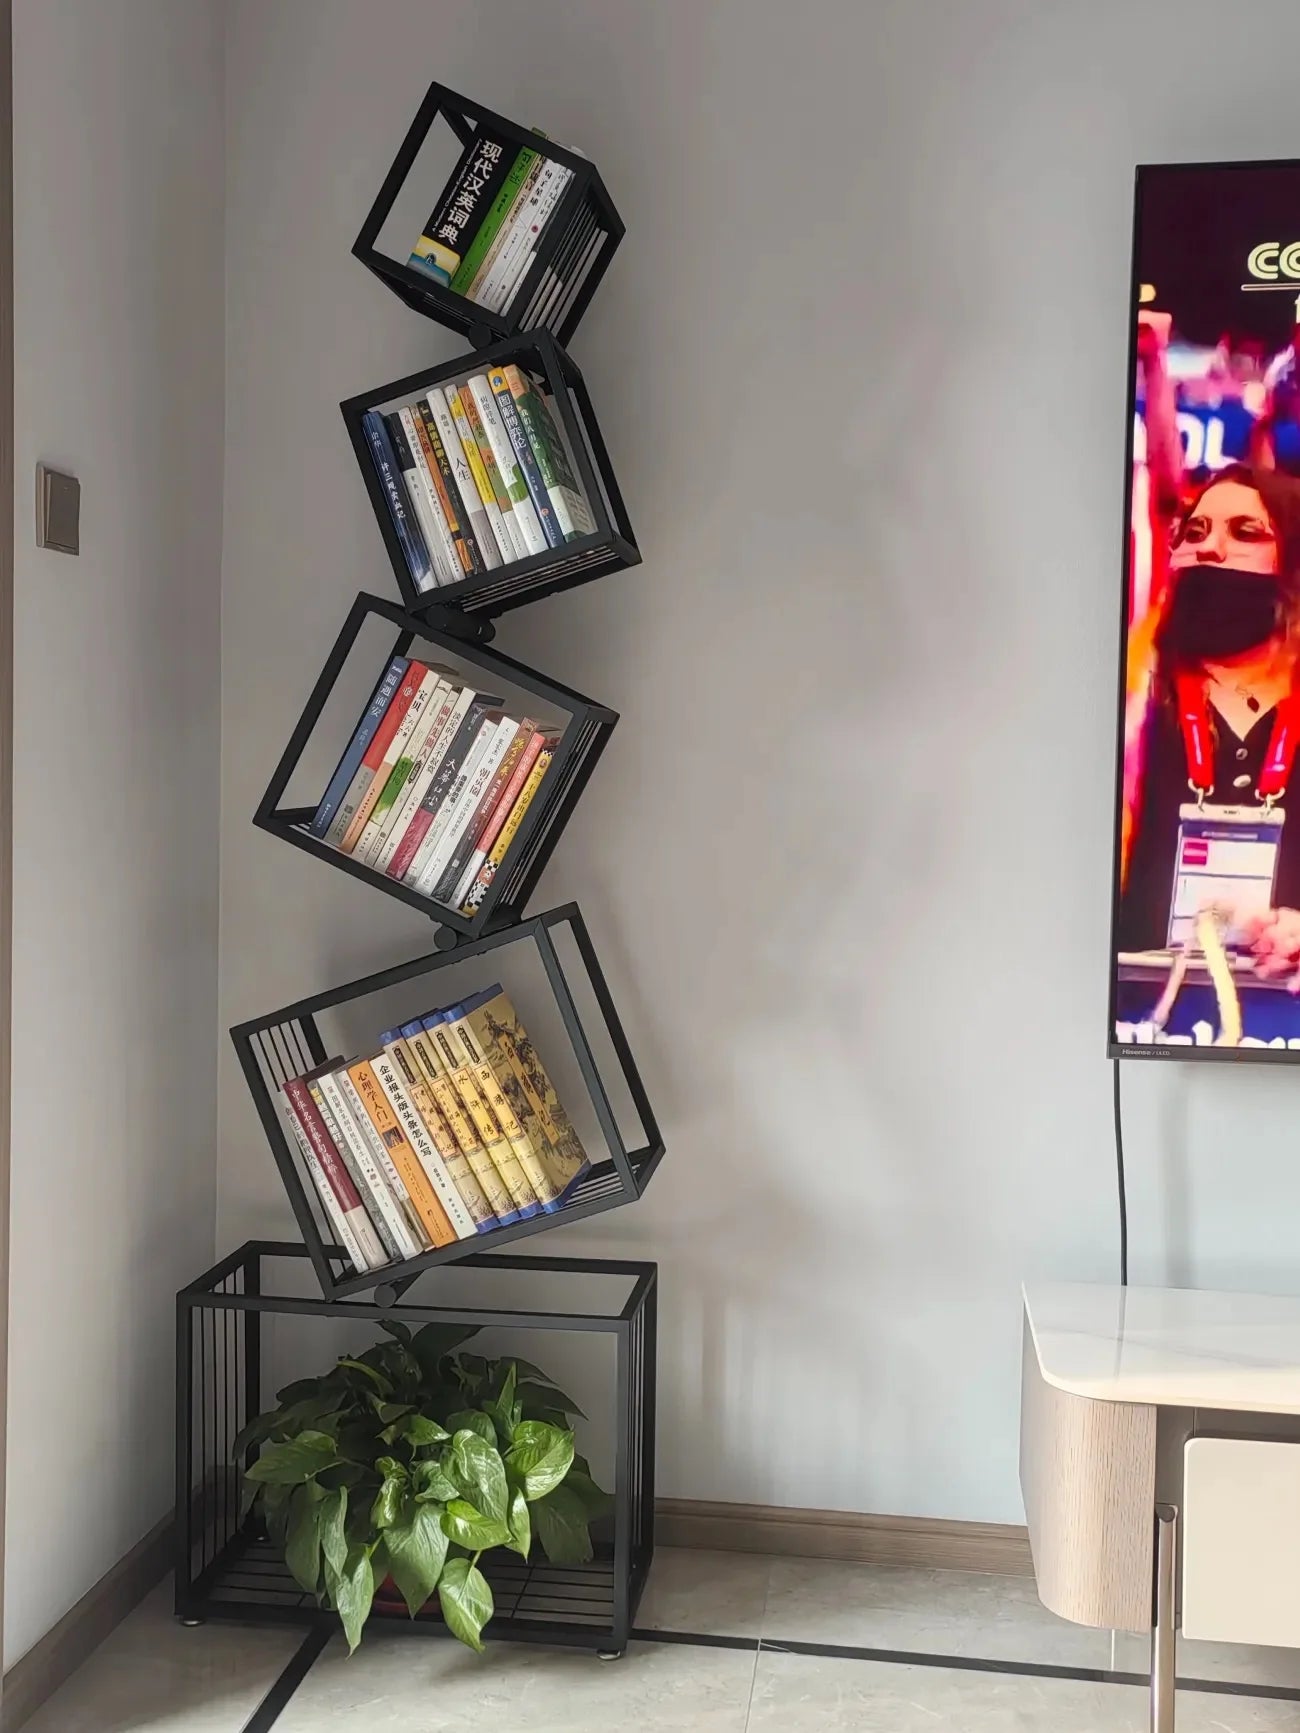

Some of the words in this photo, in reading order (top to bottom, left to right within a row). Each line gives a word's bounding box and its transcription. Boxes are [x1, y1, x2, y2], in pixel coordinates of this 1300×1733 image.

[436, 139, 503, 245] 现代汉英词典
[497, 393, 527, 450] 图解博弈论
[452, 456, 470, 482] 人生
[368, 672, 397, 718] 随遇而安
[355, 1069, 389, 1123] 心理学入门
[378, 1063, 432, 1158] 企业报头版头条怎么写
[456, 1073, 494, 1137] 水浒传
[479, 1069, 518, 1132] 西游记
